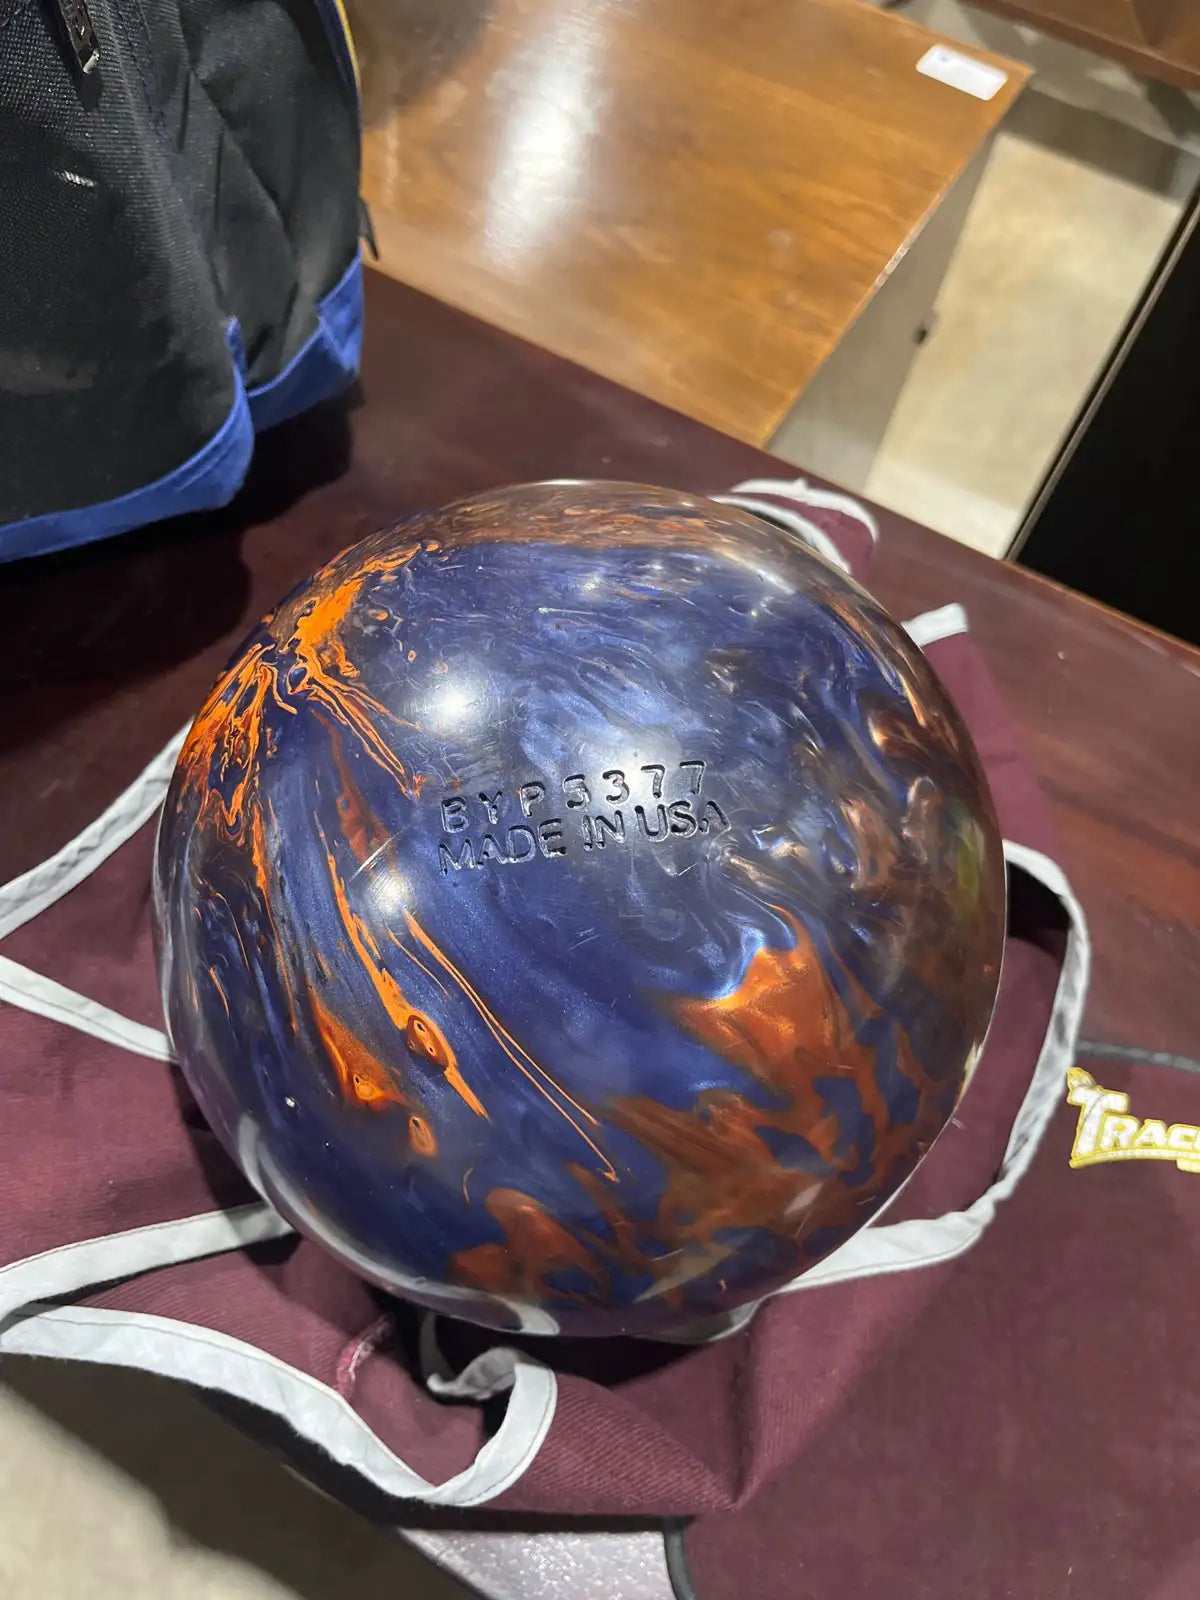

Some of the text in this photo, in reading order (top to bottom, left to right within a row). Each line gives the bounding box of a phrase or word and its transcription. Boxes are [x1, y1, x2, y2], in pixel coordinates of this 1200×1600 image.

[439, 800, 732, 876] MADE IN USA
[1067, 1084, 1200, 1158] TRAC
